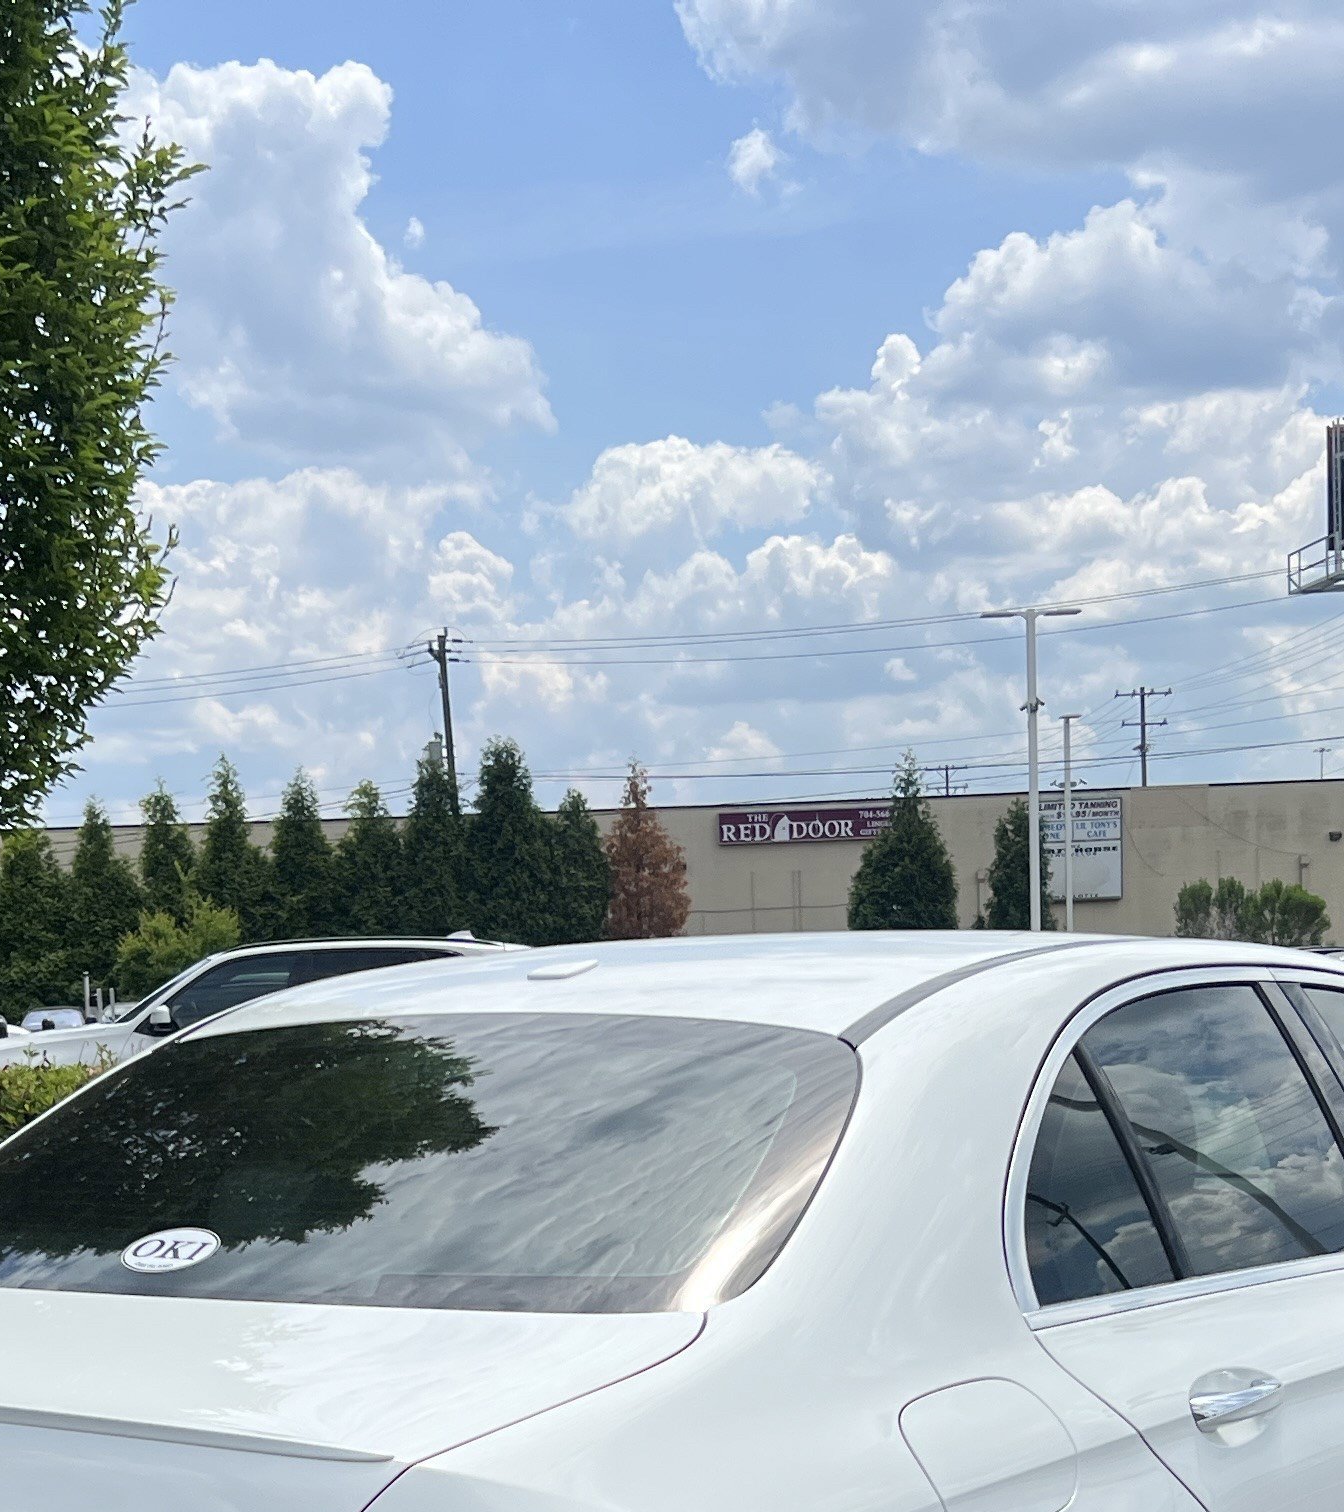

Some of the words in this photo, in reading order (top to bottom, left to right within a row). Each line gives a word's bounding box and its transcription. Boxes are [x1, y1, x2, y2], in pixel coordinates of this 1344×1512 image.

[1078, 801, 1118, 809] TANNING
[746, 814, 769, 823] THE
[721, 823, 771, 842] RED
[790, 819, 854, 839] DOOR
[132, 1239, 212, 1260] OKI
